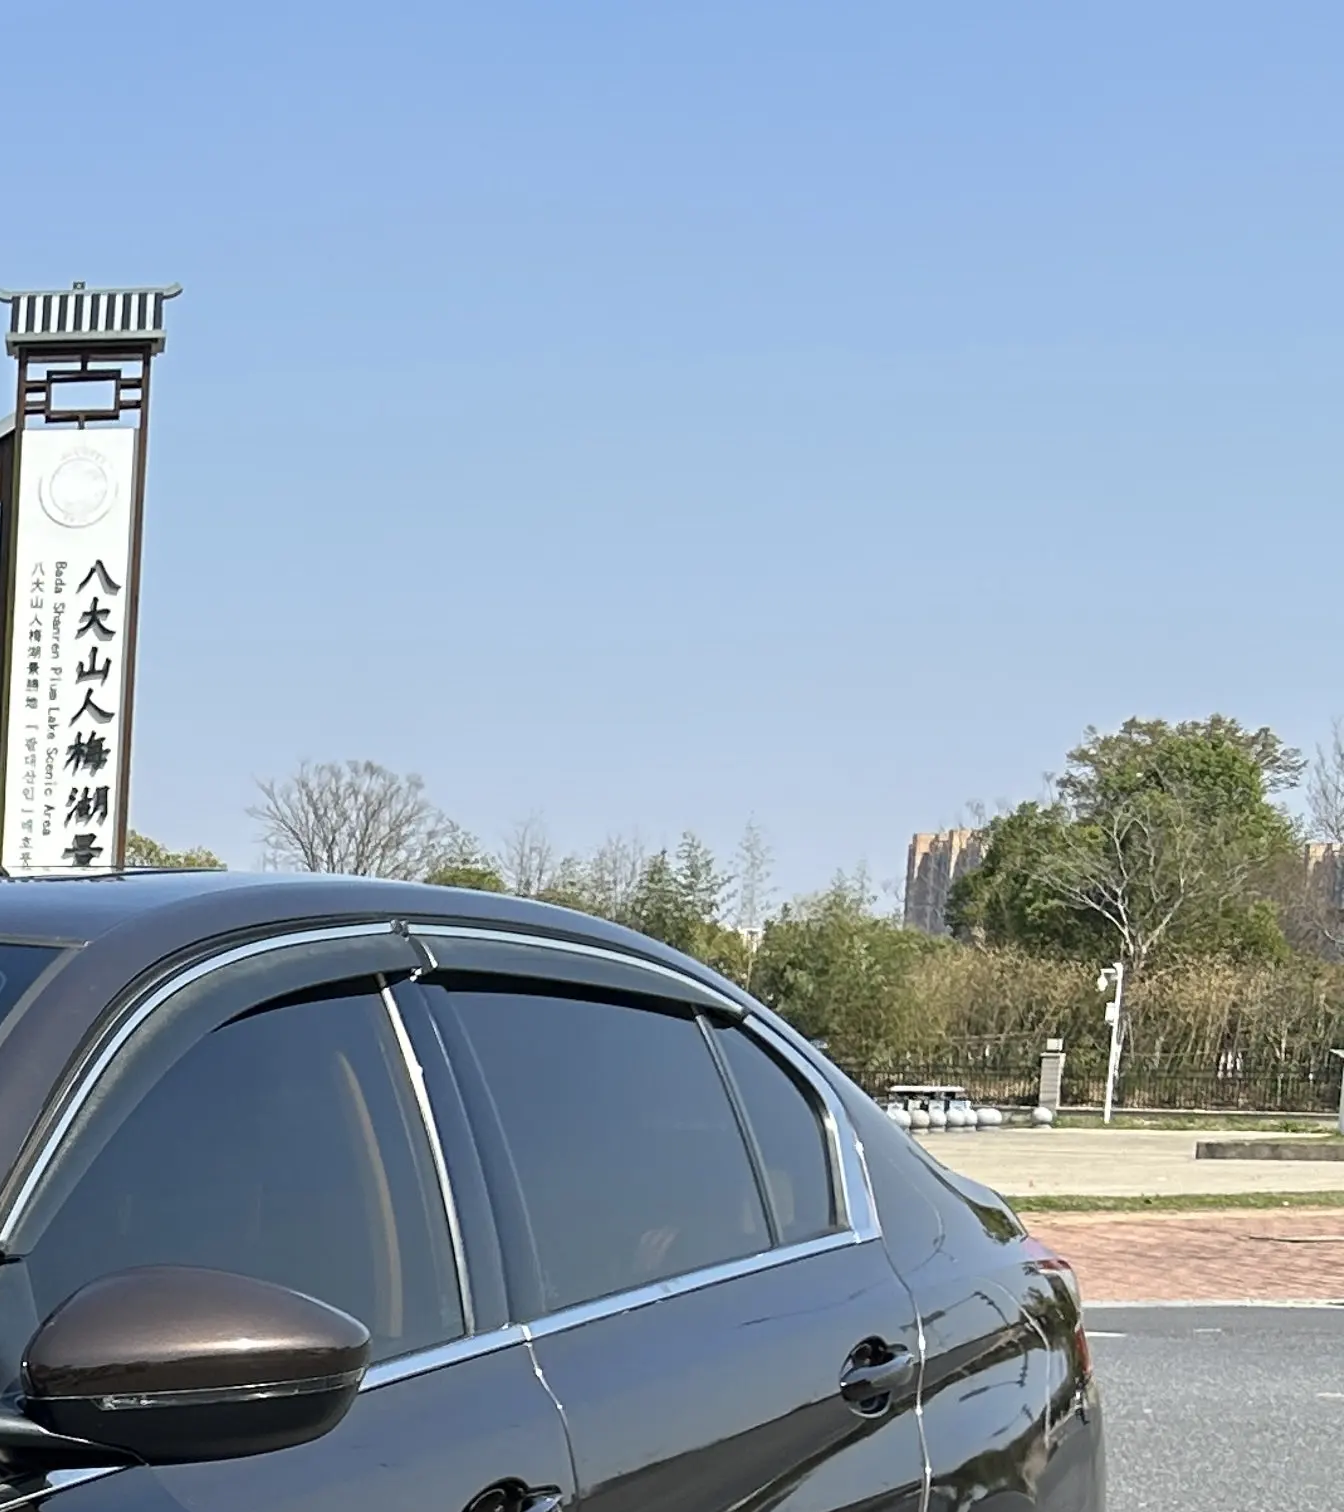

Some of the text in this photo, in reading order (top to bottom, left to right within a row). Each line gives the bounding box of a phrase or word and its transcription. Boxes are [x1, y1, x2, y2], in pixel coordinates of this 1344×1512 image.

[54, 561, 68, 594] Bada
[46, 706, 60, 740] Lake
[43, 747, 59, 797] Scenic
[42, 804, 55, 836] Area
